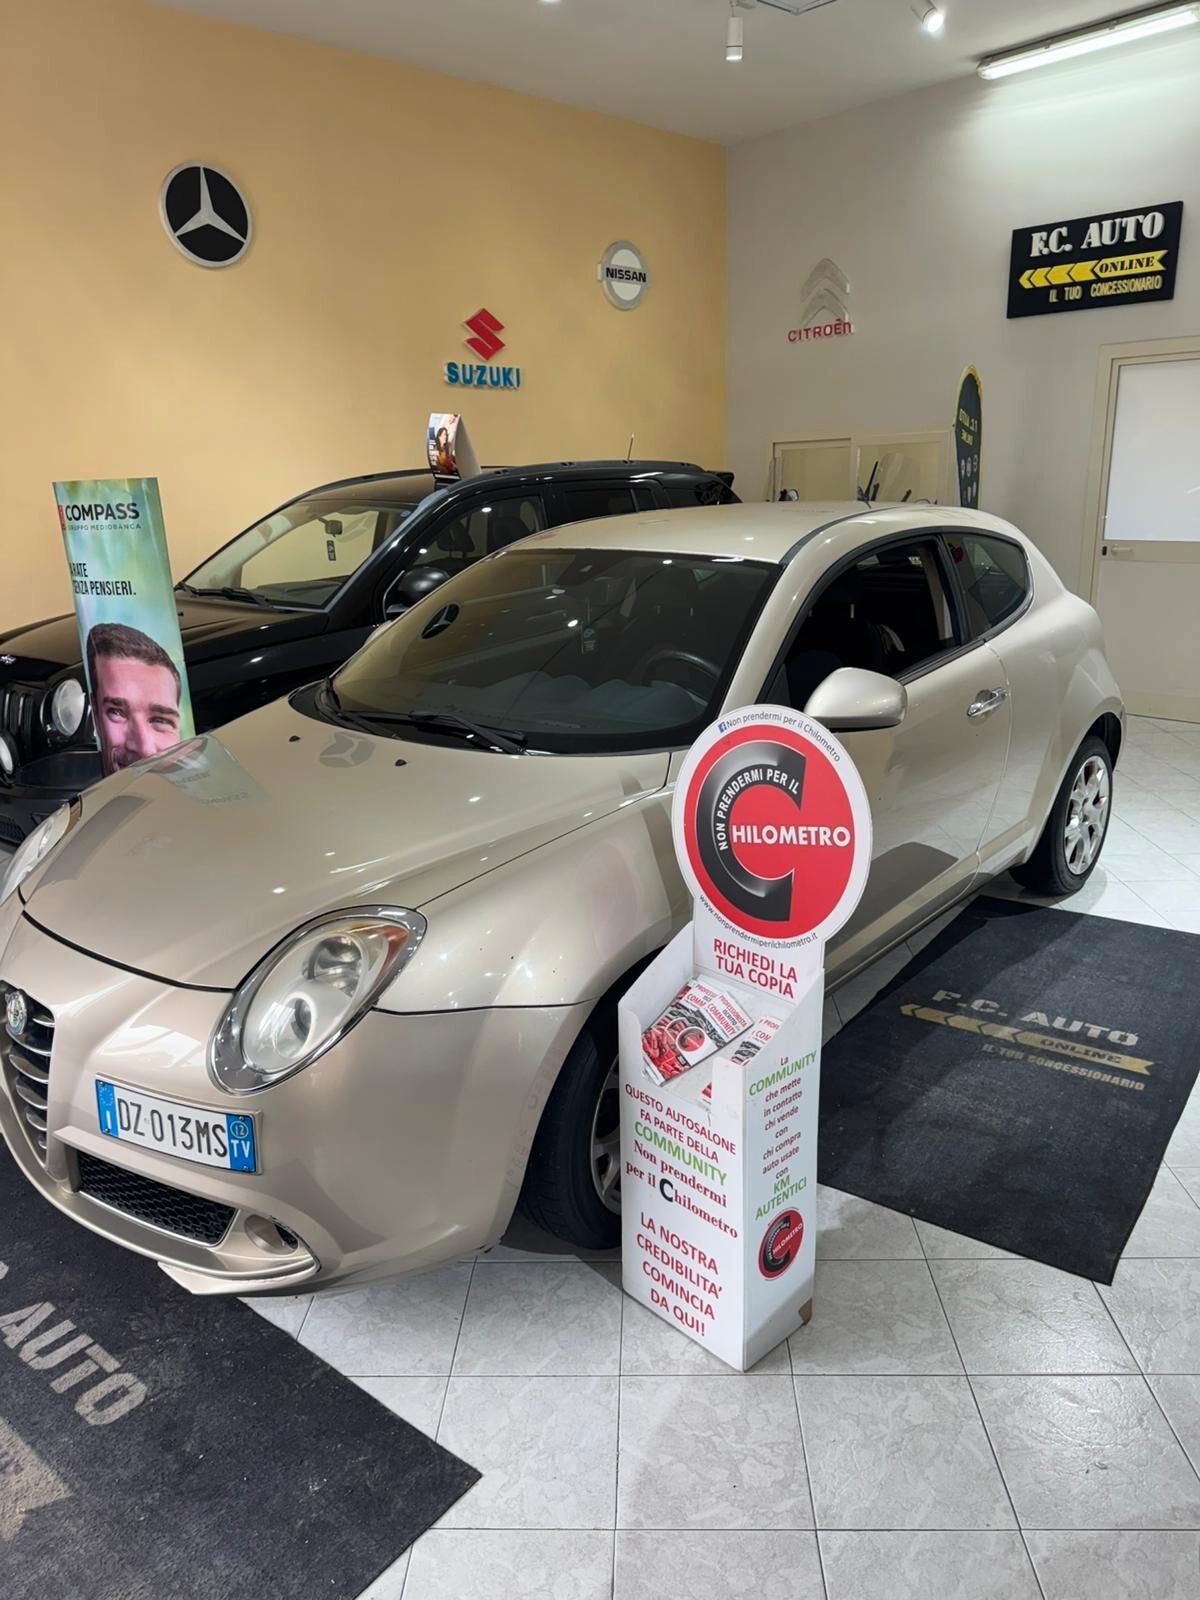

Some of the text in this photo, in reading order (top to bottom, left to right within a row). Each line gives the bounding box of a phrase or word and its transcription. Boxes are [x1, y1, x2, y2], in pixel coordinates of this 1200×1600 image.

[1030, 211, 1165, 257] F.C. AUTO
[606, 267, 646, 282] NISSAN
[1099, 256, 1155, 274] ONLINE
[1049, 275, 1163, 303] IL TUO CONCESSIONARIO
[446, 361, 520, 388] SUZUKI
[65, 502, 140, 521] COMPASS
[90, 580, 136, 596] PENSIERI.
[726, 716, 742, 728] Non
[743, 711, 782, 725] prendermi
[783, 716, 796, 726] per
[803, 723, 840, 762] Chilometro
[716, 768, 799, 851] NON PRENDERMI PER IL
[700, 895, 818, 949] www.nonprendermiperilchilometro.it
[714, 938, 797, 983] RICHIEDI LA
[716, 955, 794, 998] TUA COPIA
[707, 1003, 737, 1036] COMMUNITY
[1020, 1011, 1140, 1047] AUTO
[781, 1057, 789, 1066] La
[1040, 1038, 1123, 1064] ONLINE
[749, 1050, 817, 1096] COMMUNITY
[999, 1047, 1024, 1060] TUO
[1027, 1055, 1145, 1091] CONCESSIONARIO
[763, 1090, 802, 1118] in contatto
[765, 1077, 801, 1102] che mette
[234, 1125, 246, 1136] 12
[625, 1083, 736, 1155] QUESTO AUTOSALONE
[640, 1108, 719, 1163] FA PARTE DELLA
[764, 1106, 799, 1131] chi vende
[775, 1126, 788, 1139] con
[230, 1139, 250, 1158] TV
[634, 1121, 727, 1186] COMMUNITY
[762, 1146, 800, 1175] auto usate
[763, 1132, 801, 1160] chi compra
[634, 1139, 727, 1208] Non prendermi
[773, 1175, 790, 1194] KM
[775, 1167, 788, 1179] con
[625, 1161, 738, 1238] per il Chilometro
[755, 1176, 807, 1221] AUTENTICI
[641, 1211, 718, 1275] LA NOSTRA
[642, 1261, 715, 1320] COMINCIA
[650, 1288, 705, 1336] DA QUI!
[0, 1300, 148, 1426] AUTO
